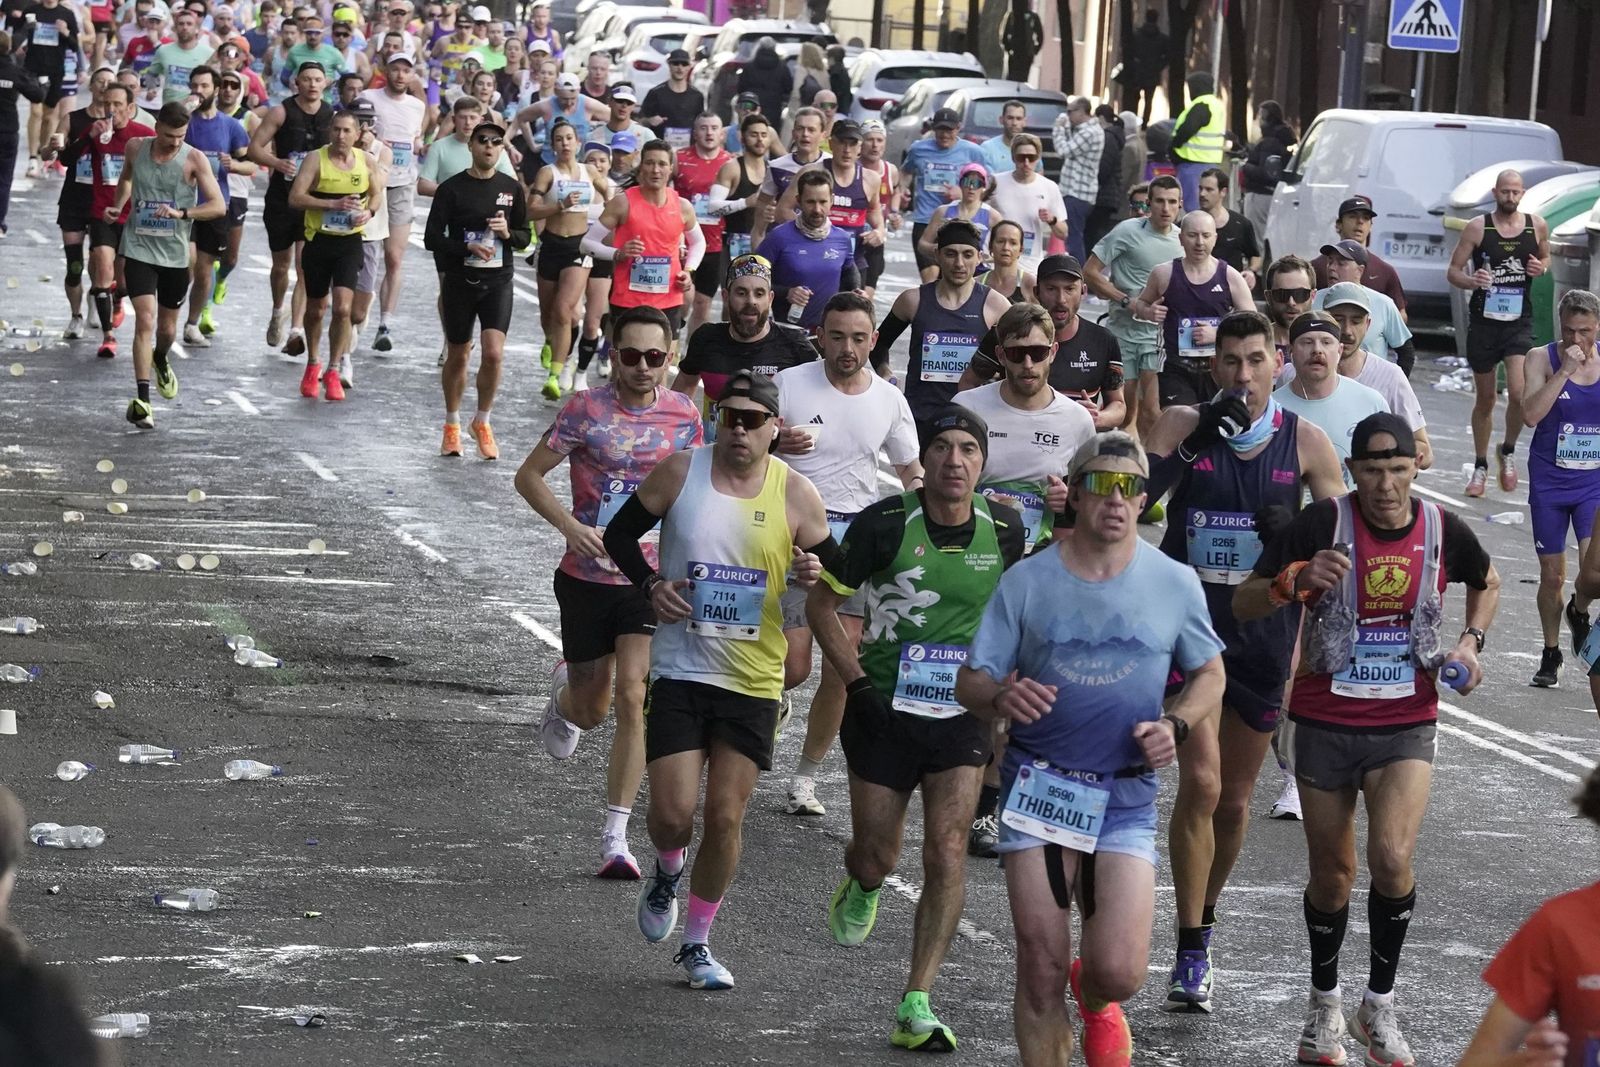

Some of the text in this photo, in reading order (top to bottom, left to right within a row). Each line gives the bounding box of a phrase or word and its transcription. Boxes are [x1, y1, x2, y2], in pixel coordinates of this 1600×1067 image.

[1392, 243, 1420, 255] 9177
[638, 275, 663, 283] PABLO
[1497, 305, 1509, 313] VIK
[941, 336, 972, 344] ZURICH
[752, 365, 778, 375] 226ERS
[1034, 431, 1060, 444] TCE
[1556, 450, 1580, 459] JUAN
[1211, 516, 1255, 527] ZURICH
[1212, 538, 1236, 548] 8265
[1206, 551, 1240, 567] LELE
[1366, 555, 1412, 567] ATHLETISME
[713, 569, 758, 582] ZURICH
[712, 590, 736, 602] 7114
[1365, 601, 1404, 610] SIX-FOURS
[703, 604, 741, 622] RAÚL
[1365, 632, 1409, 642] ZURICH
[929, 672, 953, 682] 7566
[1349, 664, 1402, 681] ABDOU
[1047, 785, 1075, 803] 9590
[1017, 792, 1096, 832] THIBAULT
